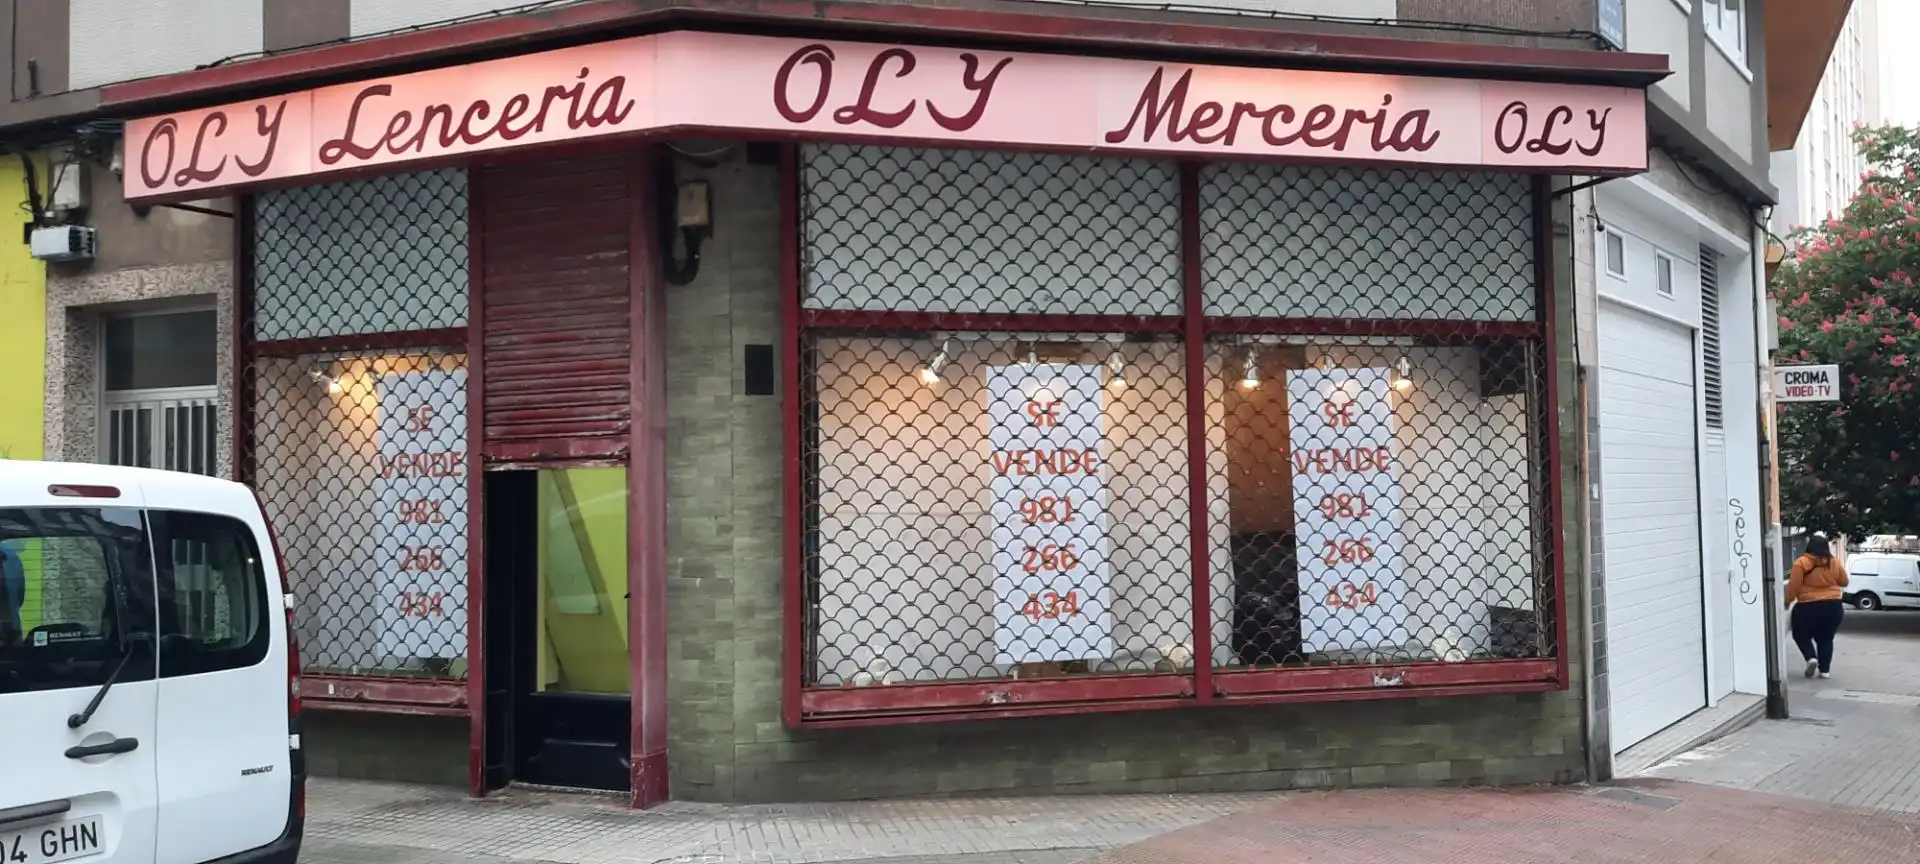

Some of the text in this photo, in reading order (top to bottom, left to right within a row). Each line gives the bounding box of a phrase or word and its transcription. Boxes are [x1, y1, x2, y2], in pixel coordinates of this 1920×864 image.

[773, 44, 1013, 131] OLY
[319, 67, 634, 165] Lencería
[1105, 65, 1440, 152] Mercería
[1495, 101, 1611, 156] OLY
[140, 100, 287, 189] OLY
[1785, 371, 1829, 384] CROMA
[408, 405, 433, 432] SE
[1027, 401, 1060, 428] SE
[1324, 401, 1355, 428] SE
[378, 451, 462, 479] VENDE
[991, 447, 1099, 476] VENDE
[1294, 446, 1391, 474] VENDE
[400, 499, 444, 524] 981
[1020, 495, 1076, 524] 981
[1320, 492, 1371, 520] 981
[400, 545, 444, 571] 266
[1022, 543, 1077, 573] 266
[1322, 537, 1373, 566] 266
[400, 591, 443, 617] 434
[1022, 591, 1078, 620] 434
[1325, 582, 1376, 609] 434
[41, 821, 97, 857] GHN
